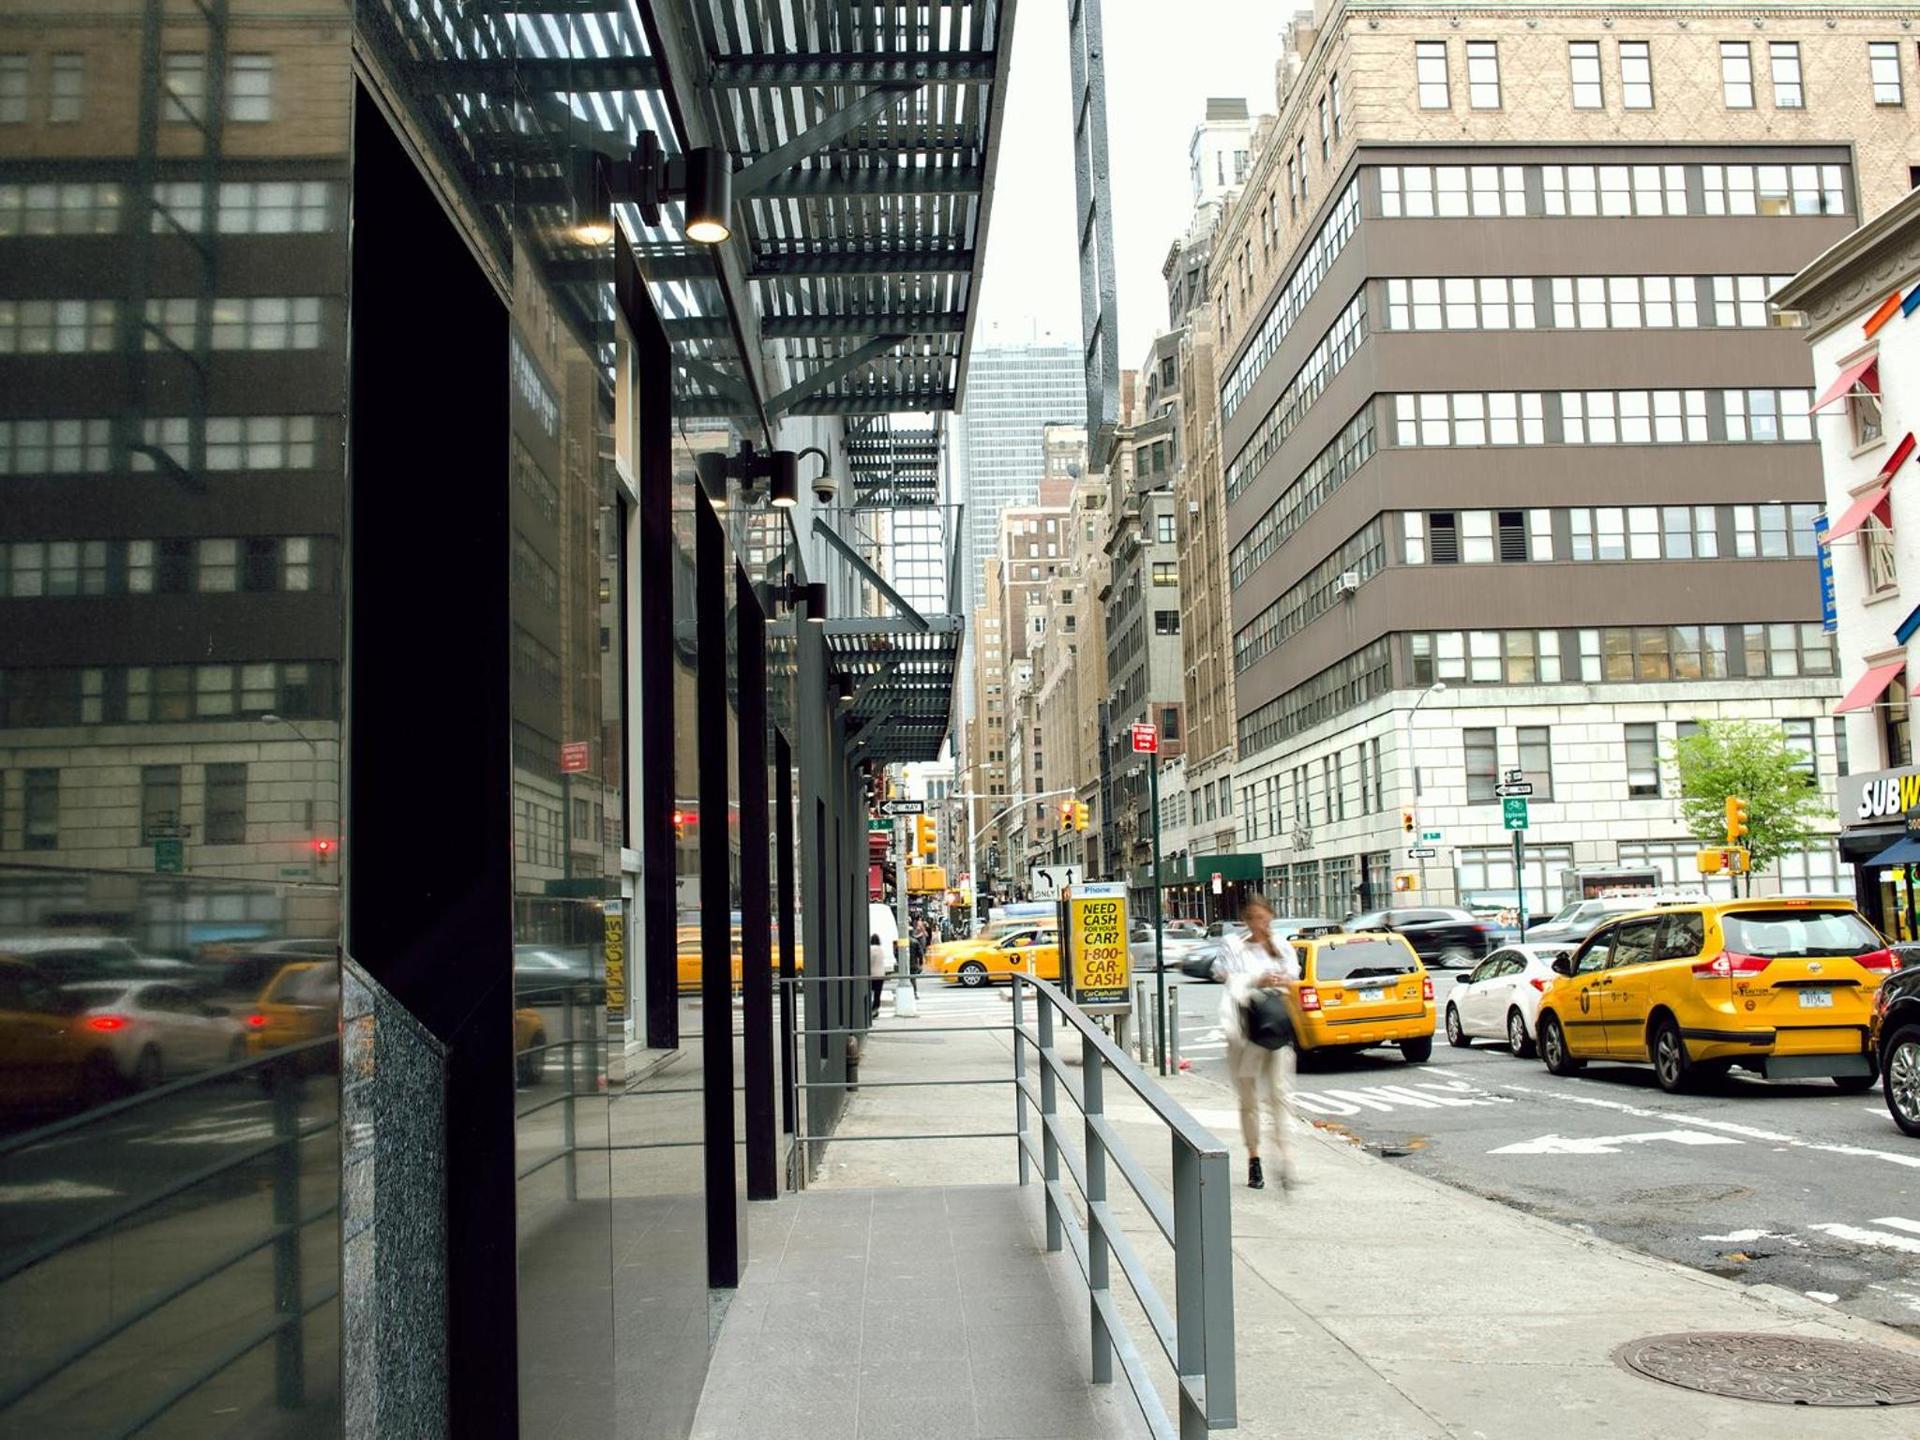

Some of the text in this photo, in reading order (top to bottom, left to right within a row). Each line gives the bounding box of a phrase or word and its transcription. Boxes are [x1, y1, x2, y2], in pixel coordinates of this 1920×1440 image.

[1035, 890, 1055, 898] ONLY
[1083, 903, 1117, 914] NEED
[1083, 914, 1117, 926] CASH
[1084, 932, 1119, 944] CAR?
[1083, 947, 1123, 960] 1-800-
[1086, 960, 1119, 973] CAR-
[1084, 973, 1123, 986] CASH
